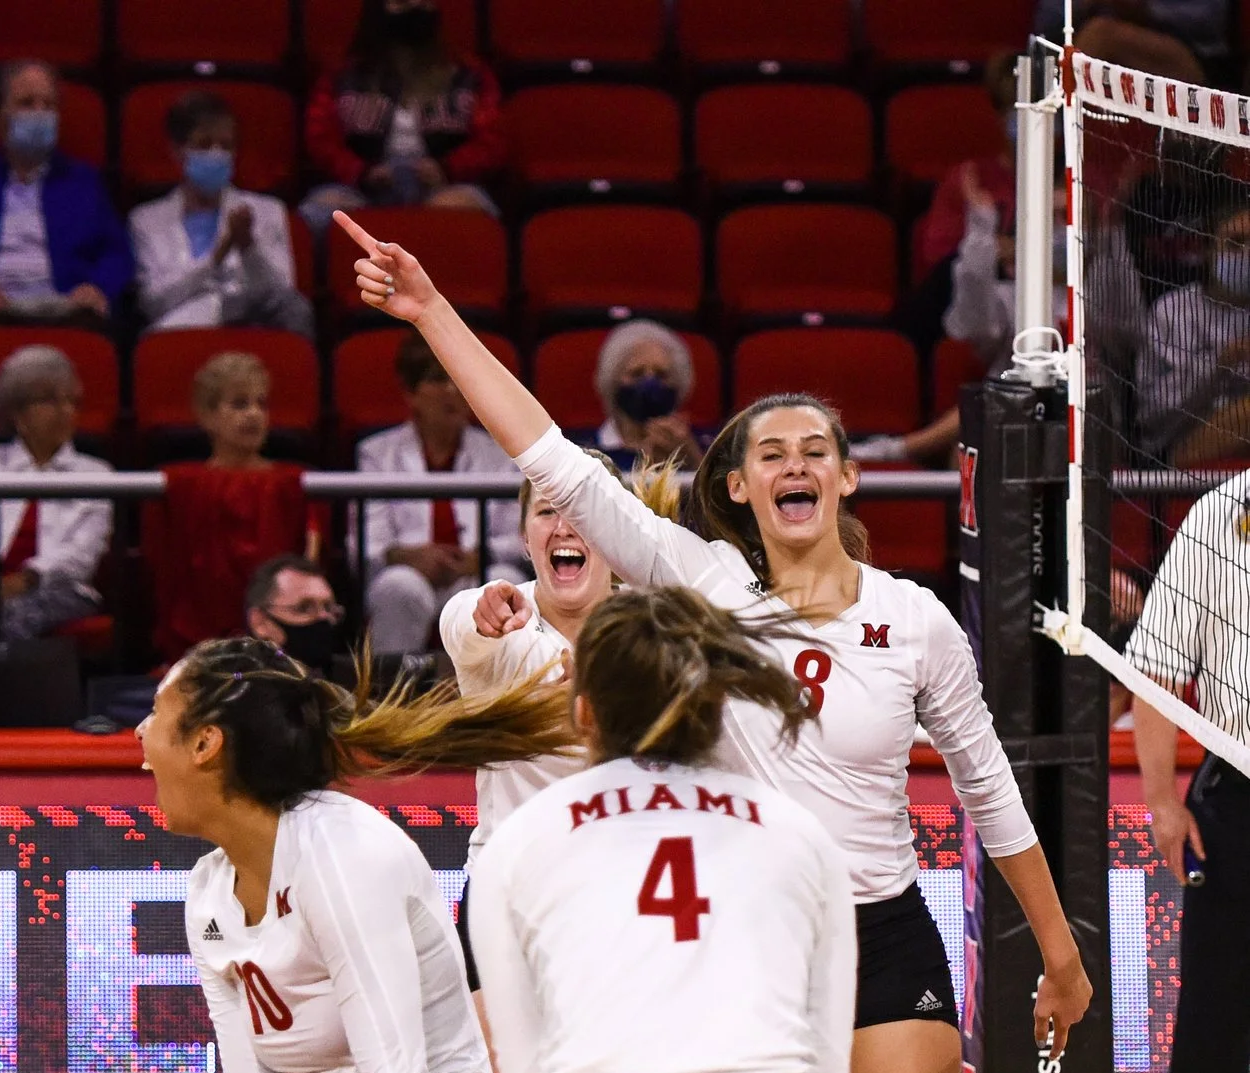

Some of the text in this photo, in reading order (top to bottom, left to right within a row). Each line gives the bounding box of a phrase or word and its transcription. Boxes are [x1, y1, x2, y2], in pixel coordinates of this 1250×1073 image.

[860, 622, 891, 648] M
[793, 648, 832, 720] 8
[567, 783, 765, 832] MIAMI
[637, 836, 711, 942] 4
[234, 960, 294, 1036] 10
